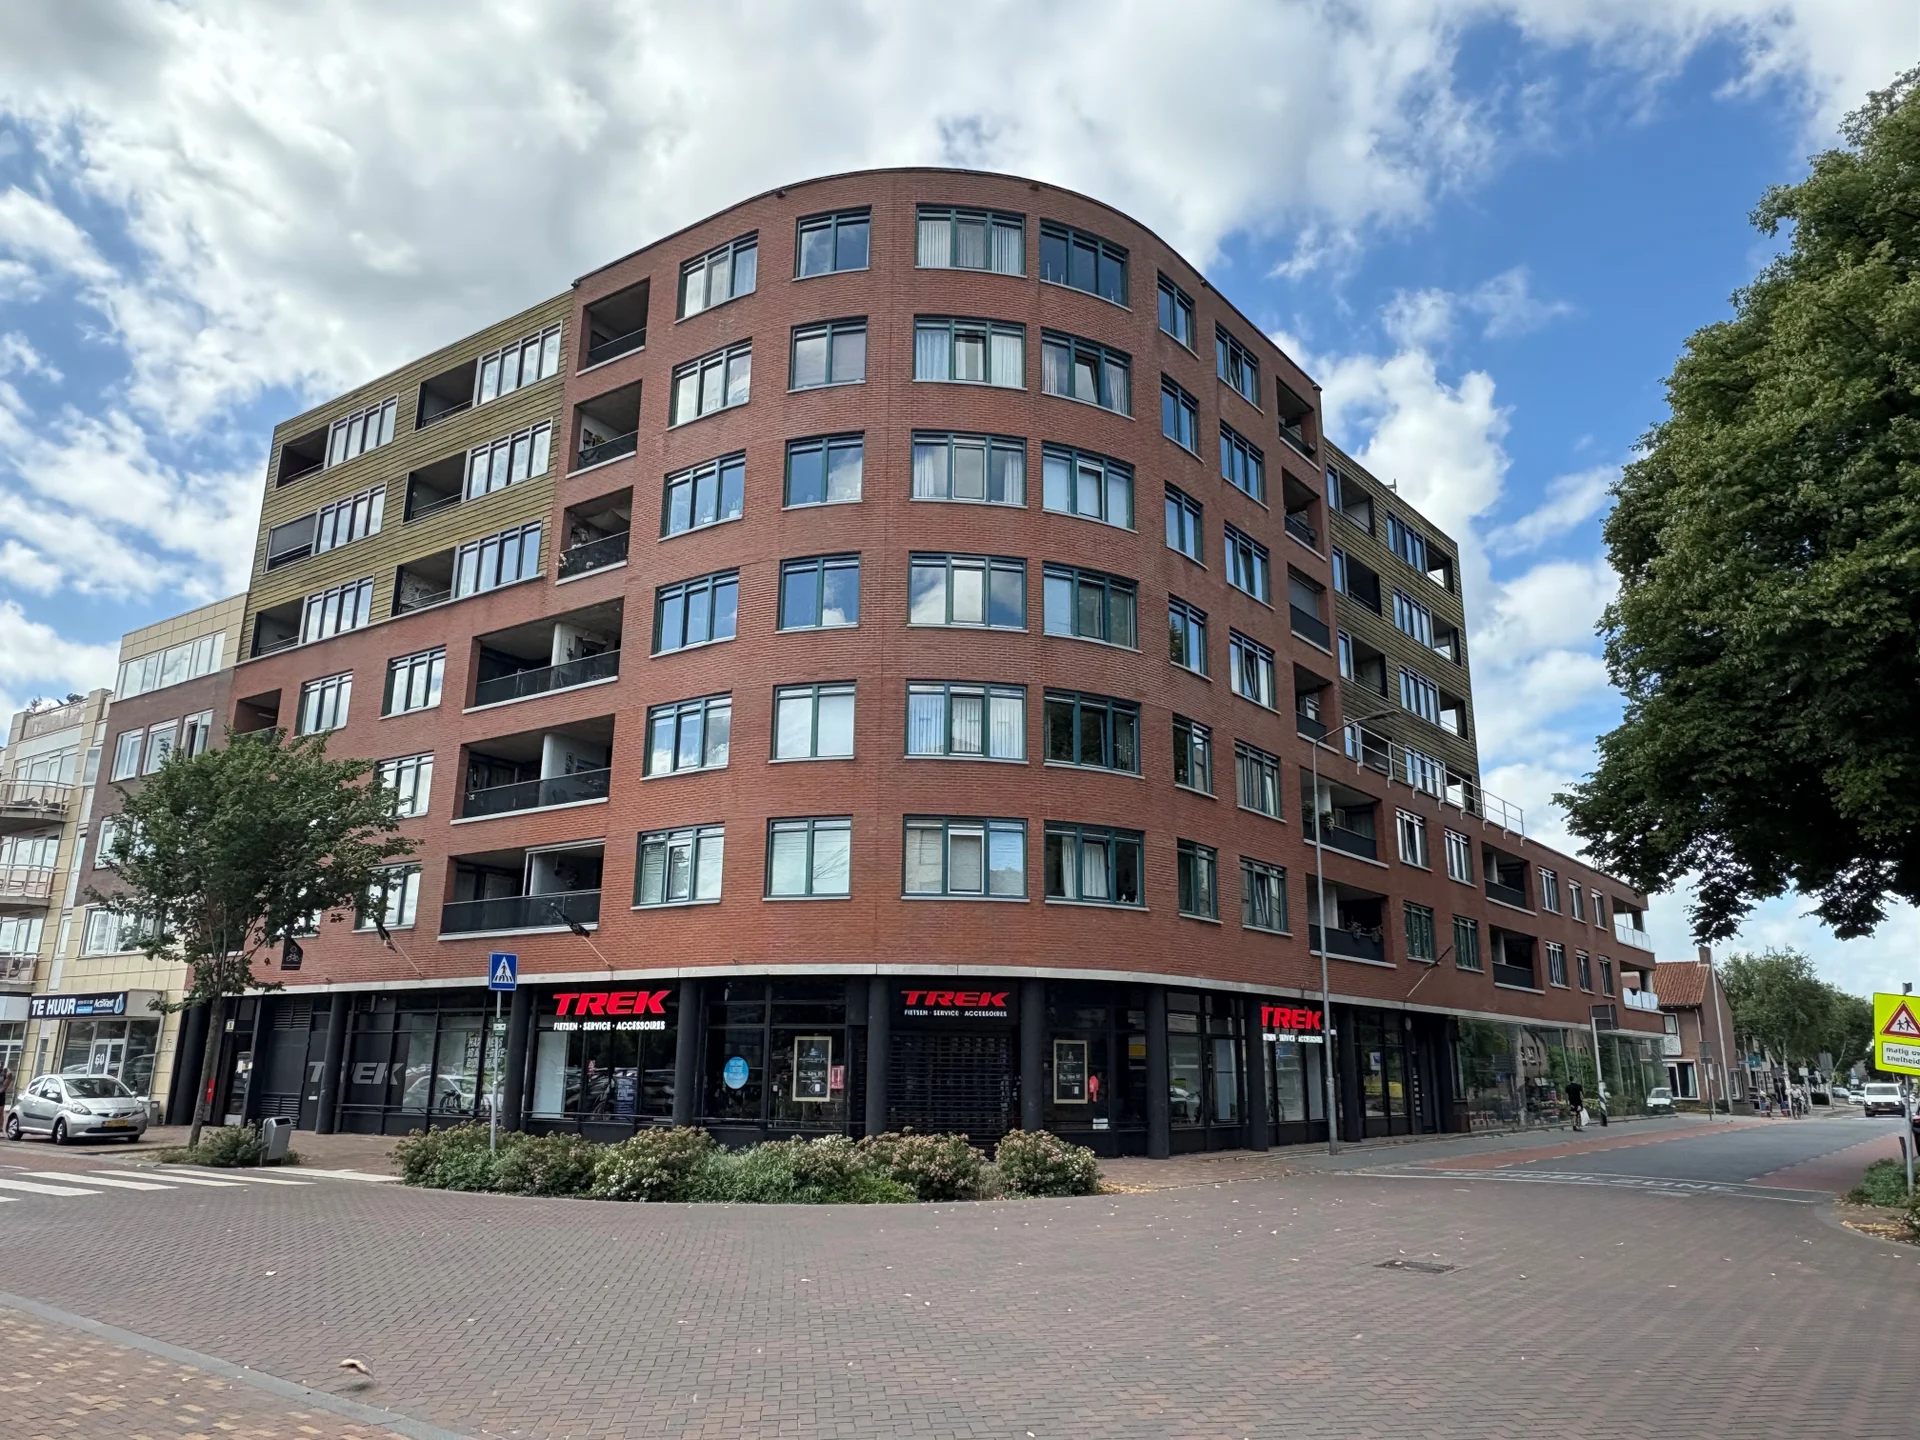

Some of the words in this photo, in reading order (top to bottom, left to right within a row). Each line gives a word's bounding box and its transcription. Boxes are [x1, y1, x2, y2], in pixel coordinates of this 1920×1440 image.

[32, 999, 46, 1016] TE
[46, 998, 77, 1016] HUUR
[552, 989, 673, 1016] TREK
[900, 990, 1010, 1007] TREK
[553, 1021, 578, 1031] FIETSEN
[582, 1021, 611, 1031] SERVICE
[616, 1020, 666, 1031] ACCESSOIRES
[1261, 1006, 1322, 1031] TREK
[1886, 1047, 1909, 1056] matig
[308, 1061, 404, 1085] TEK
